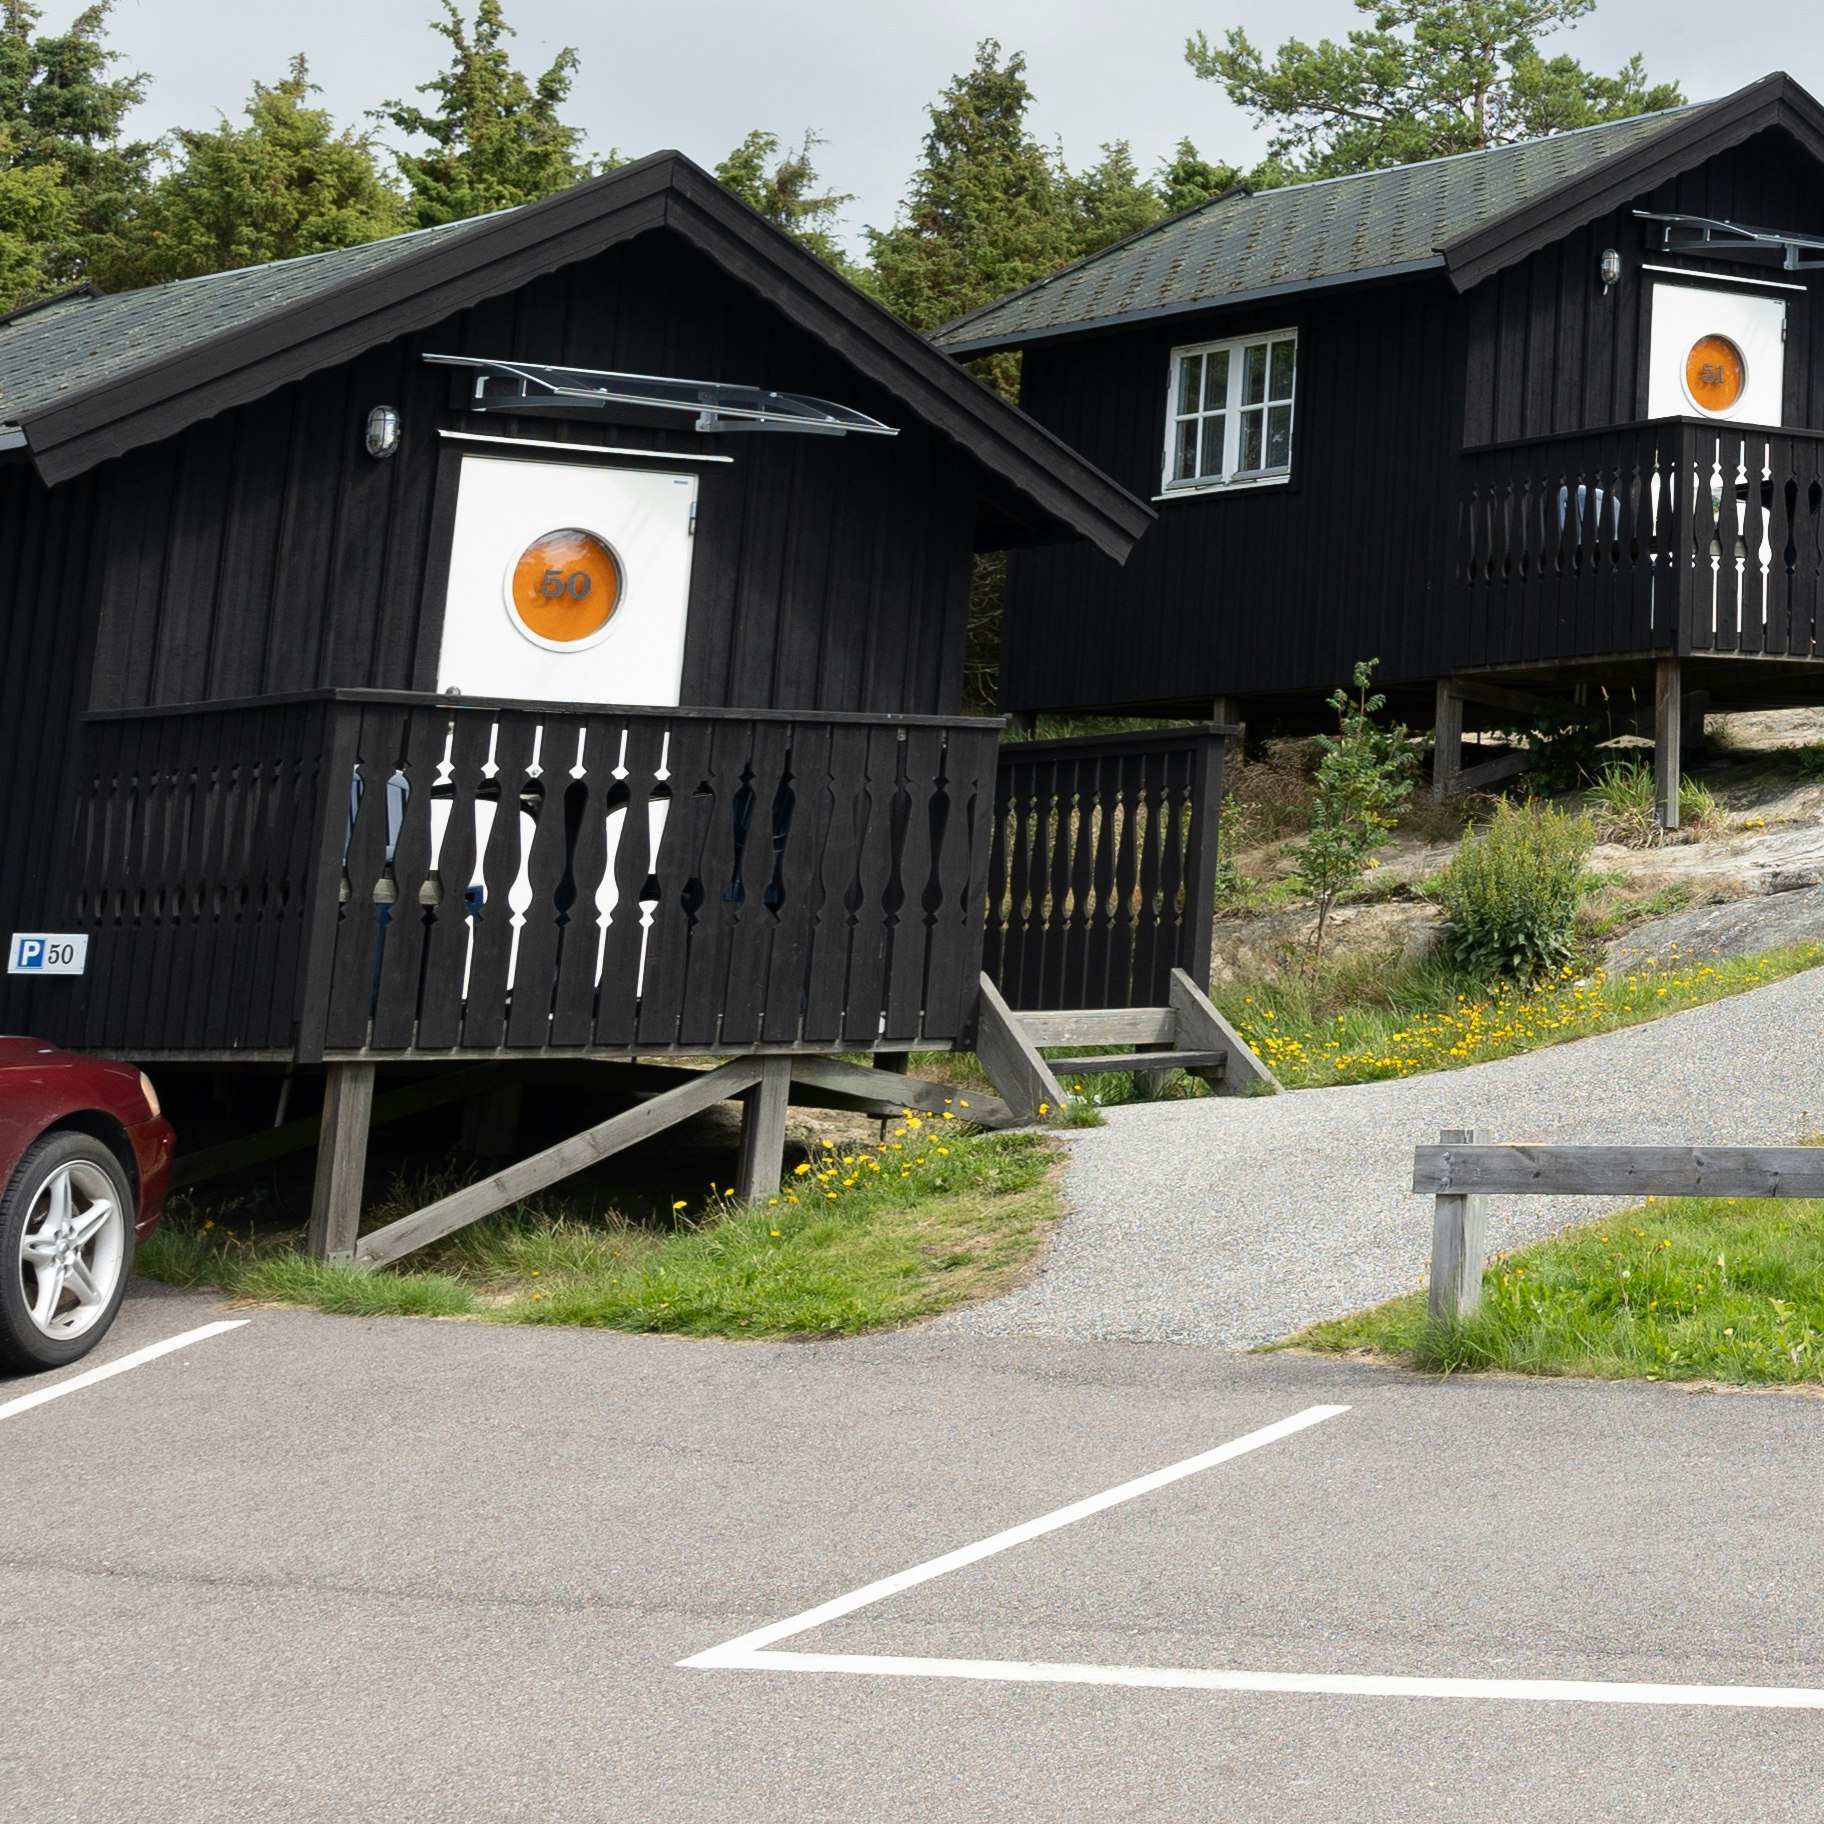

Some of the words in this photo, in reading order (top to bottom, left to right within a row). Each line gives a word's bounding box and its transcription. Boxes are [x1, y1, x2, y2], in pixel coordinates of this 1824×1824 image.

[1701, 363, 1725, 385] 51
[540, 569, 592, 600] 50
[20, 940, 41, 966] P
[47, 943, 74, 965] 50
